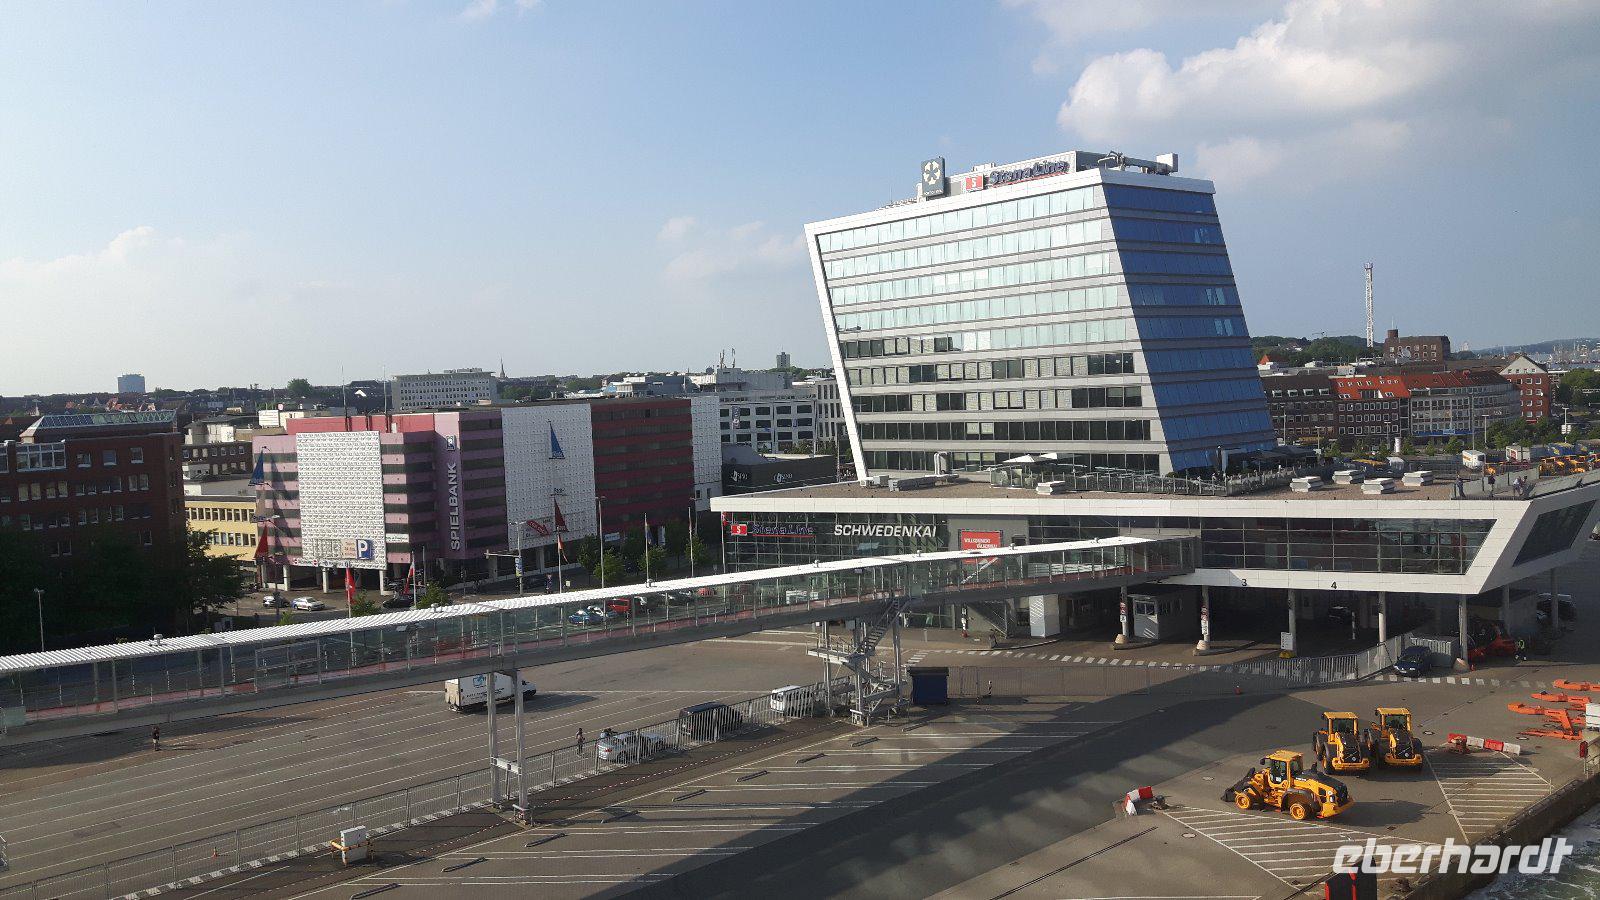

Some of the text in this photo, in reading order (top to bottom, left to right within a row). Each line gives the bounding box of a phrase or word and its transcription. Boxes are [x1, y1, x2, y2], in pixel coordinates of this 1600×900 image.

[989, 166, 1031, 184] Stena
[447, 462, 460, 550] SPIELBANK
[752, 524, 814, 535] Stena Line
[834, 524, 937, 538] SCHWEDENKAI
[357, 539, 368, 558] P
[1241, 578, 1248, 587] 3
[1330, 581, 1337, 590] 4
